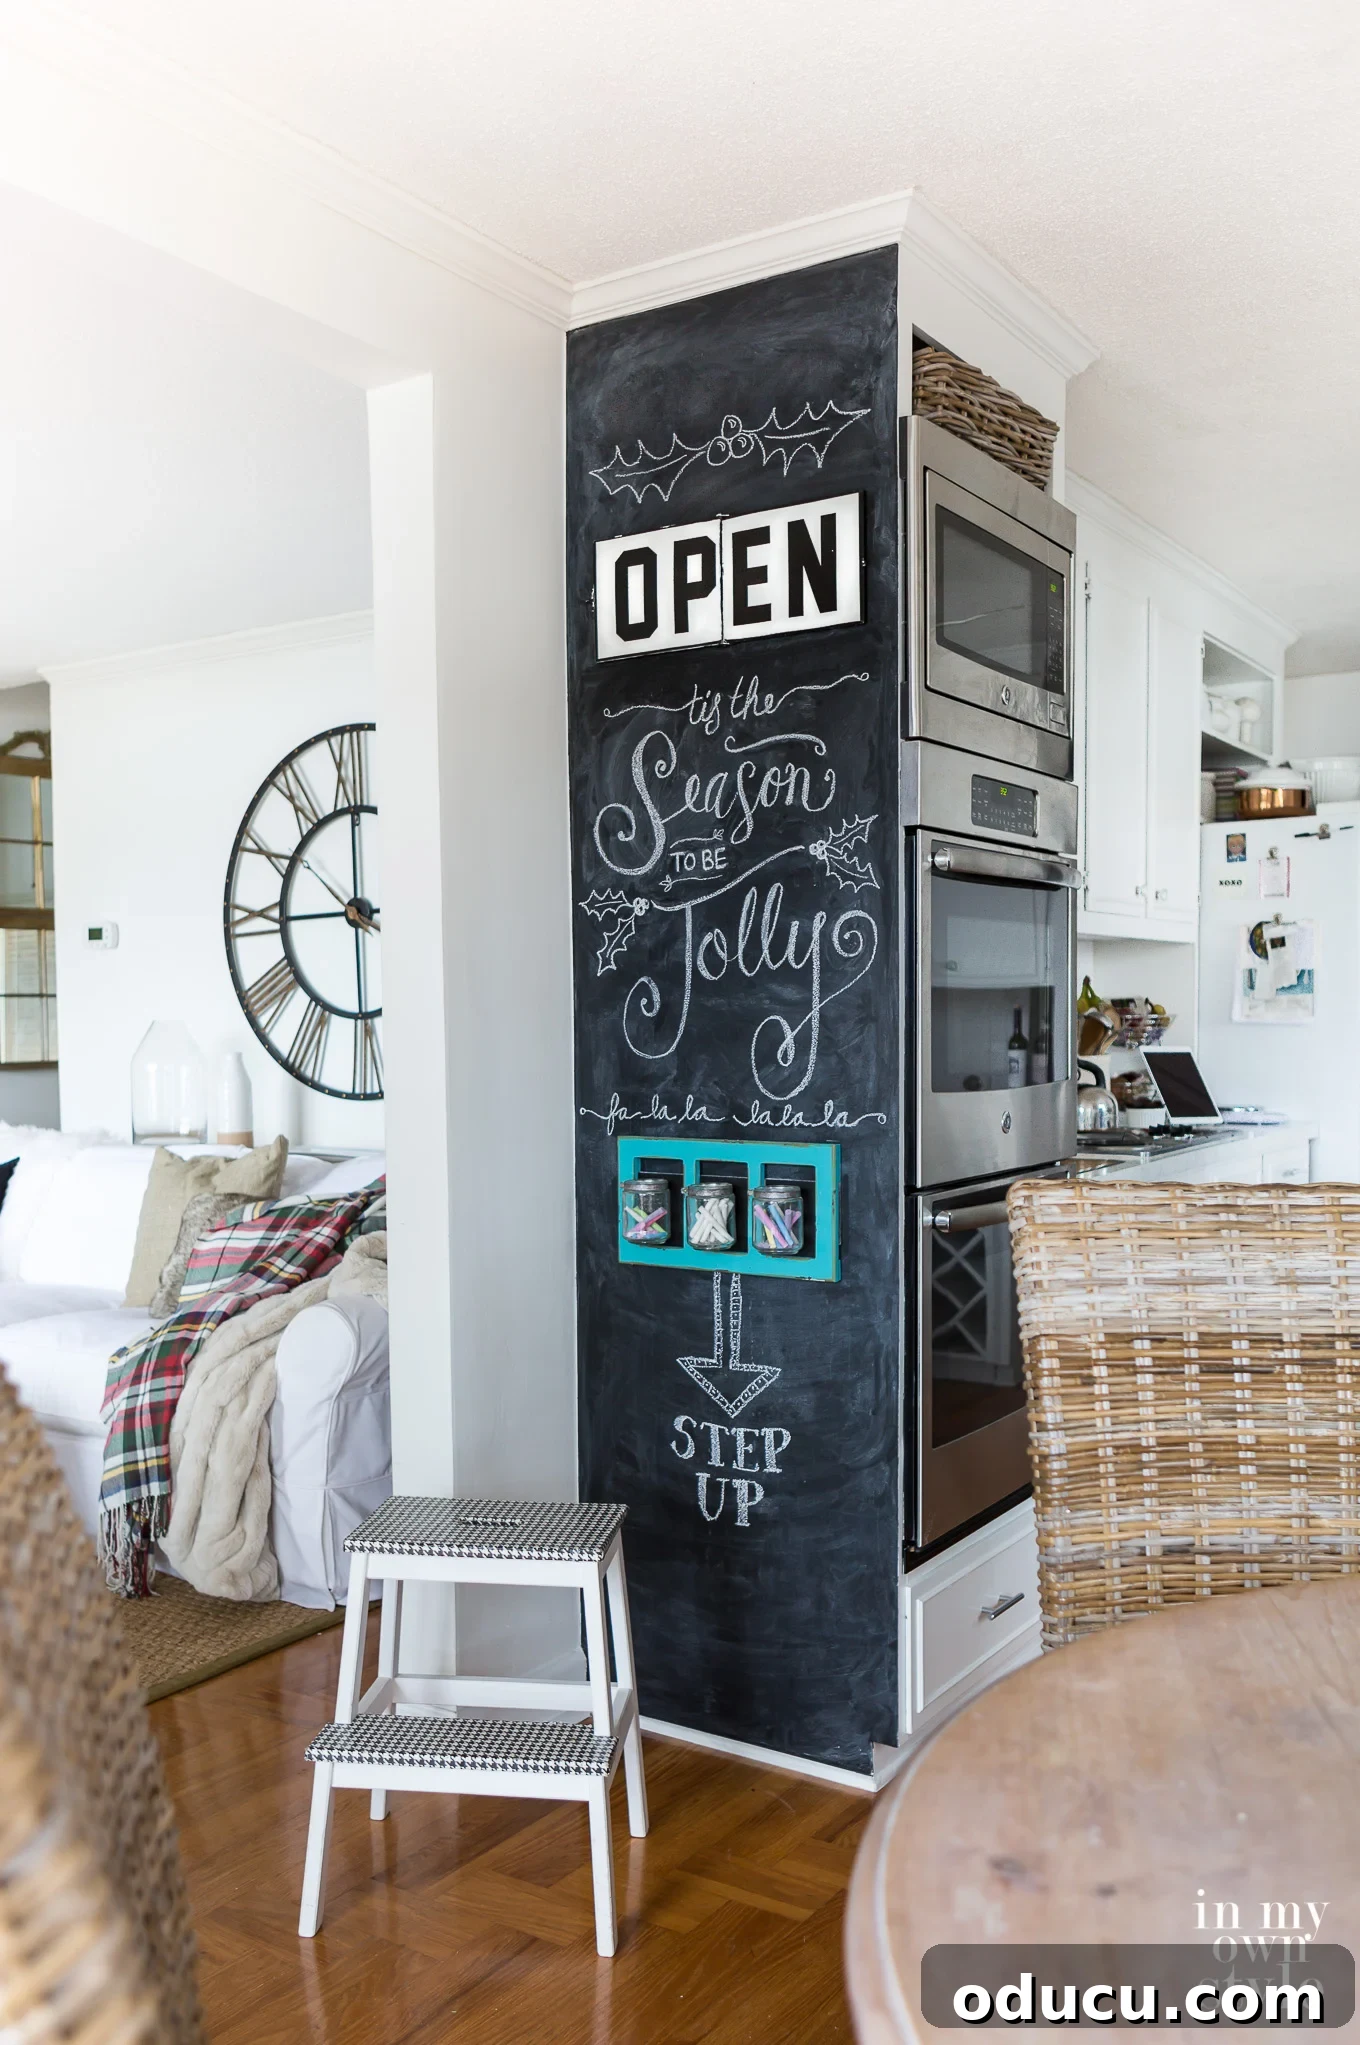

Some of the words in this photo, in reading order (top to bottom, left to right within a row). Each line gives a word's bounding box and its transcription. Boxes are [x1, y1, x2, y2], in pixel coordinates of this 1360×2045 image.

[614, 512, 838, 642] OPEN
[728, 675, 775, 720] the
[594, 730, 836, 876] Season
[670, 851, 696, 872] TO
[702, 848, 729, 871] BE
[624, 883, 878, 1101] Jolly
[606, 1092, 638, 1136] fa
[642, 1094, 676, 1120] la
[678, 1094, 715, 1124] la
[743, 1100, 774, 1127] la
[775, 1104, 807, 1127] la
[818, 1100, 857, 1128] la
[671, 1415, 792, 1474] STEP
[695, 1472, 765, 1527] UP
